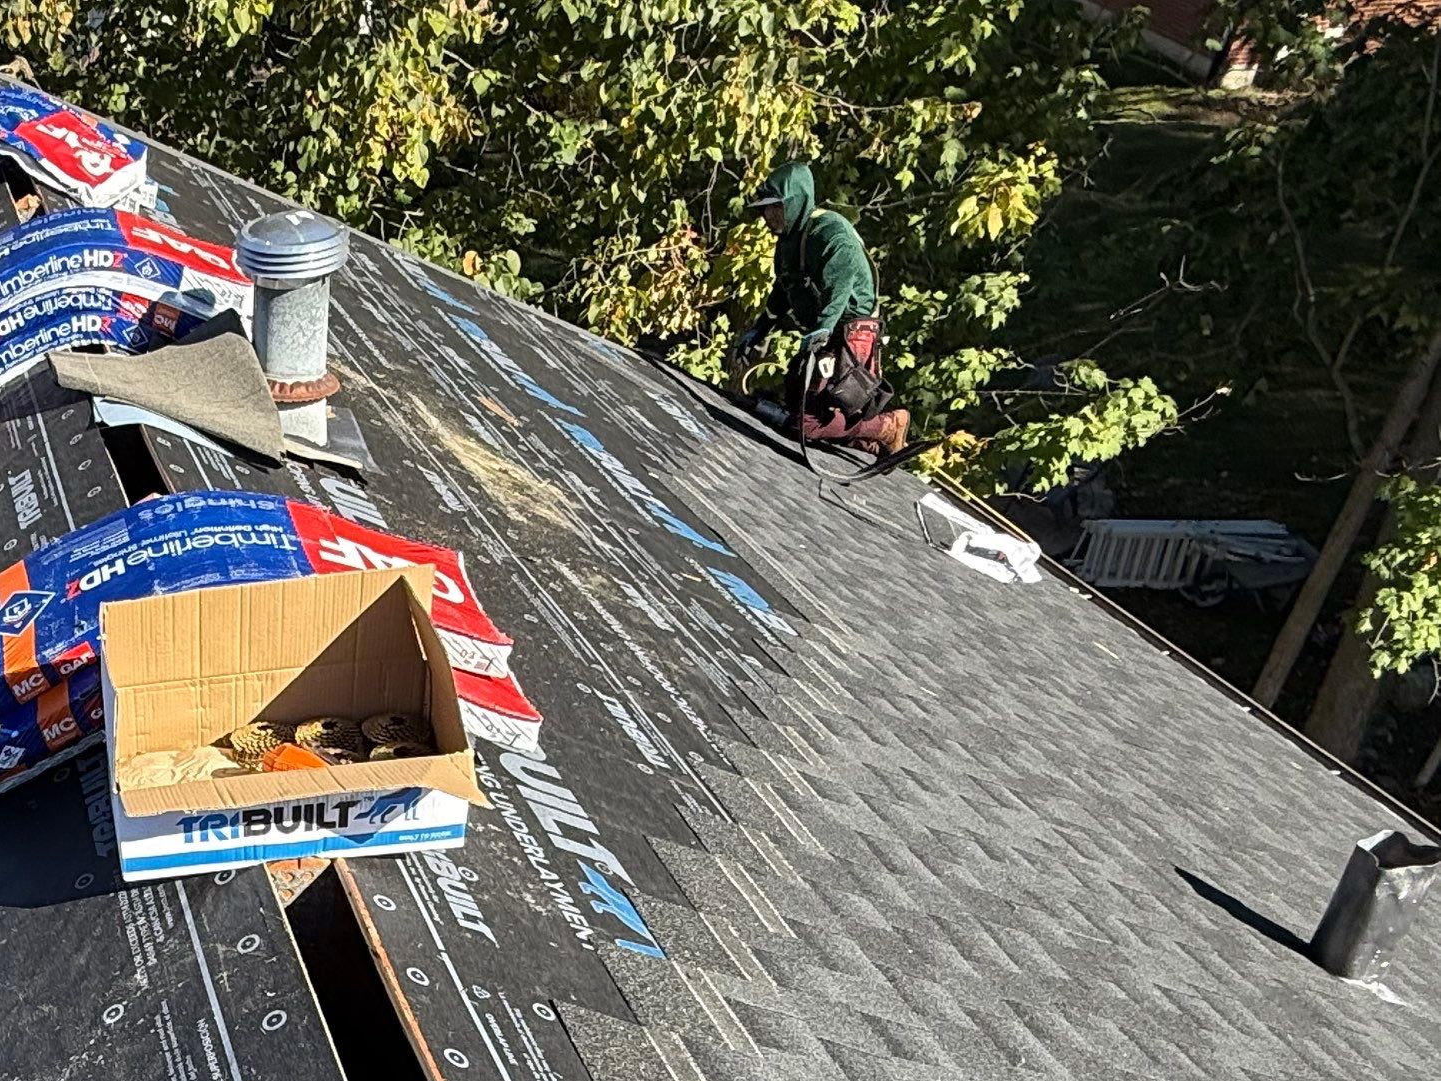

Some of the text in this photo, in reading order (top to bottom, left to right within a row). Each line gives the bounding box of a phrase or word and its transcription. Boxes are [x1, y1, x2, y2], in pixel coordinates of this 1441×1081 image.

[9, 469, 43, 531] TRIBUILT
[126, 530, 298, 566] Timberline
[64, 556, 125, 600] HDZ
[60, 654, 91, 675] GAF
[12, 672, 45, 698] MC
[41, 716, 77, 742] MC
[176, 799, 362, 845] TRIBUILT
